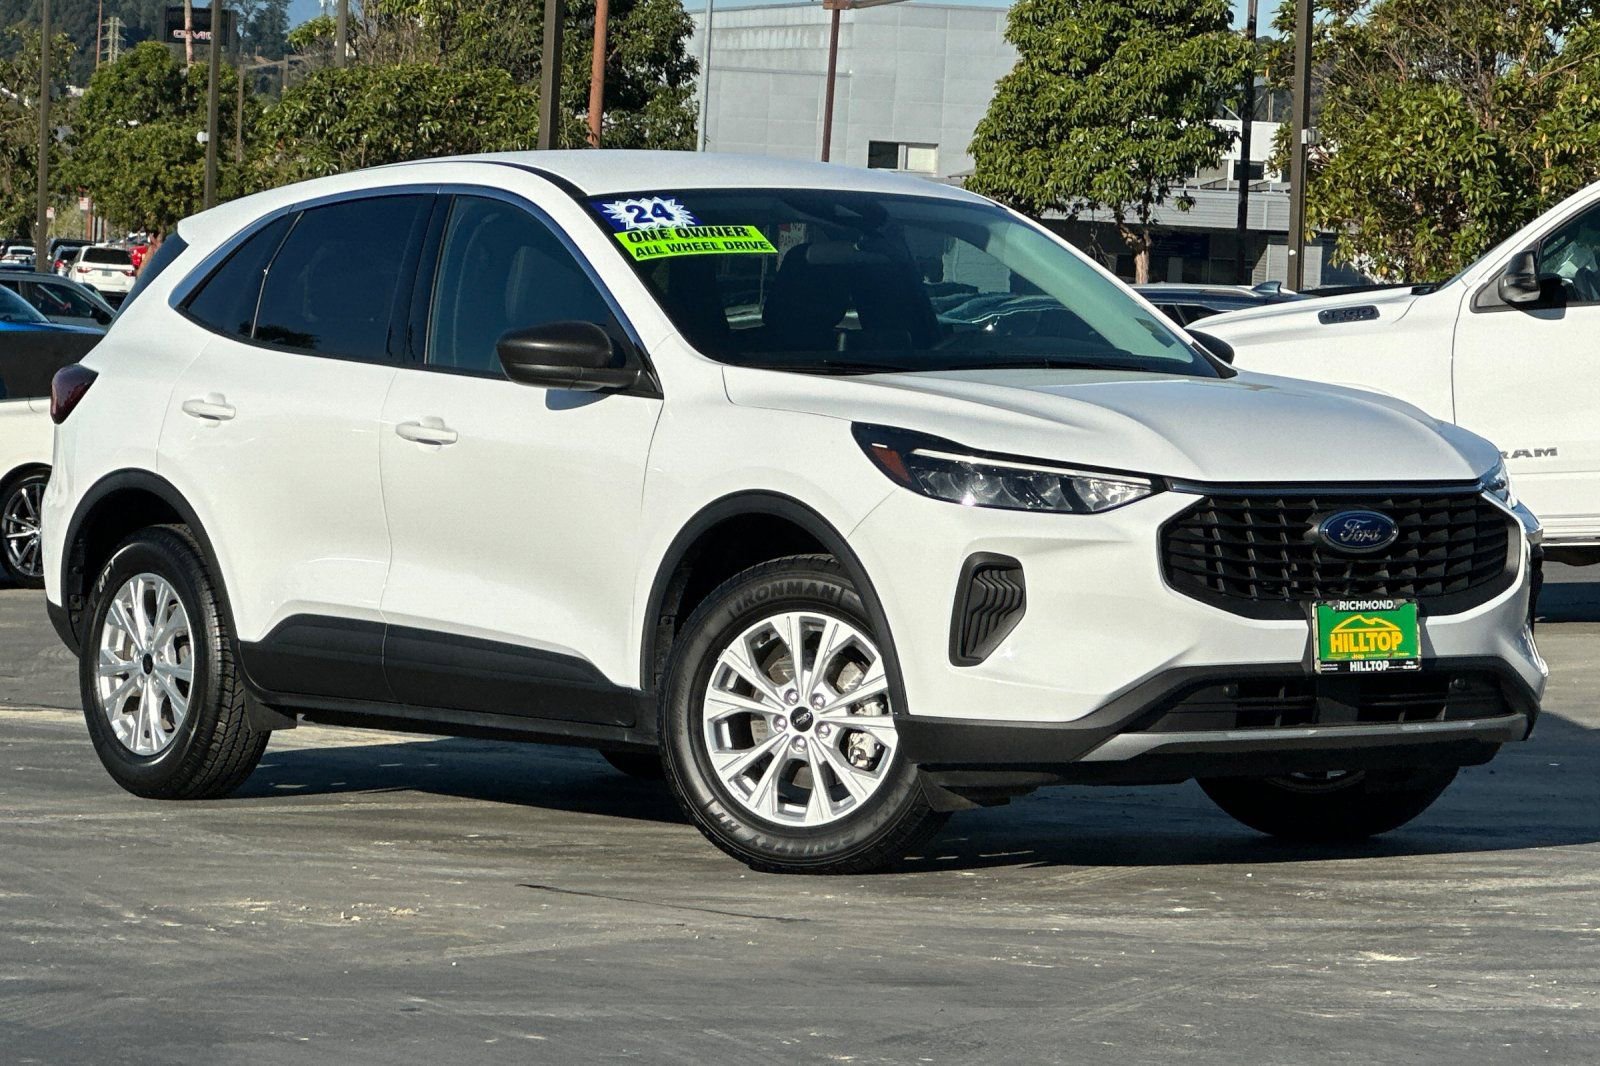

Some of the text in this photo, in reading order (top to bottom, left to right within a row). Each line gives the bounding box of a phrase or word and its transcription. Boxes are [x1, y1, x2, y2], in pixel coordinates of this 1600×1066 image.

[625, 202, 674, 224] 24
[627, 226, 749, 243] ONE OWNER
[635, 240, 772, 258] ALL WHEEL DRIVE
[1340, 519, 1382, 542] Ford
[735, 581, 838, 611] IRONMAN
[1339, 600, 1394, 611] RICHMOND
[1330, 631, 1403, 653] HILLTOP
[1349, 661, 1390, 672] HILLTOP
